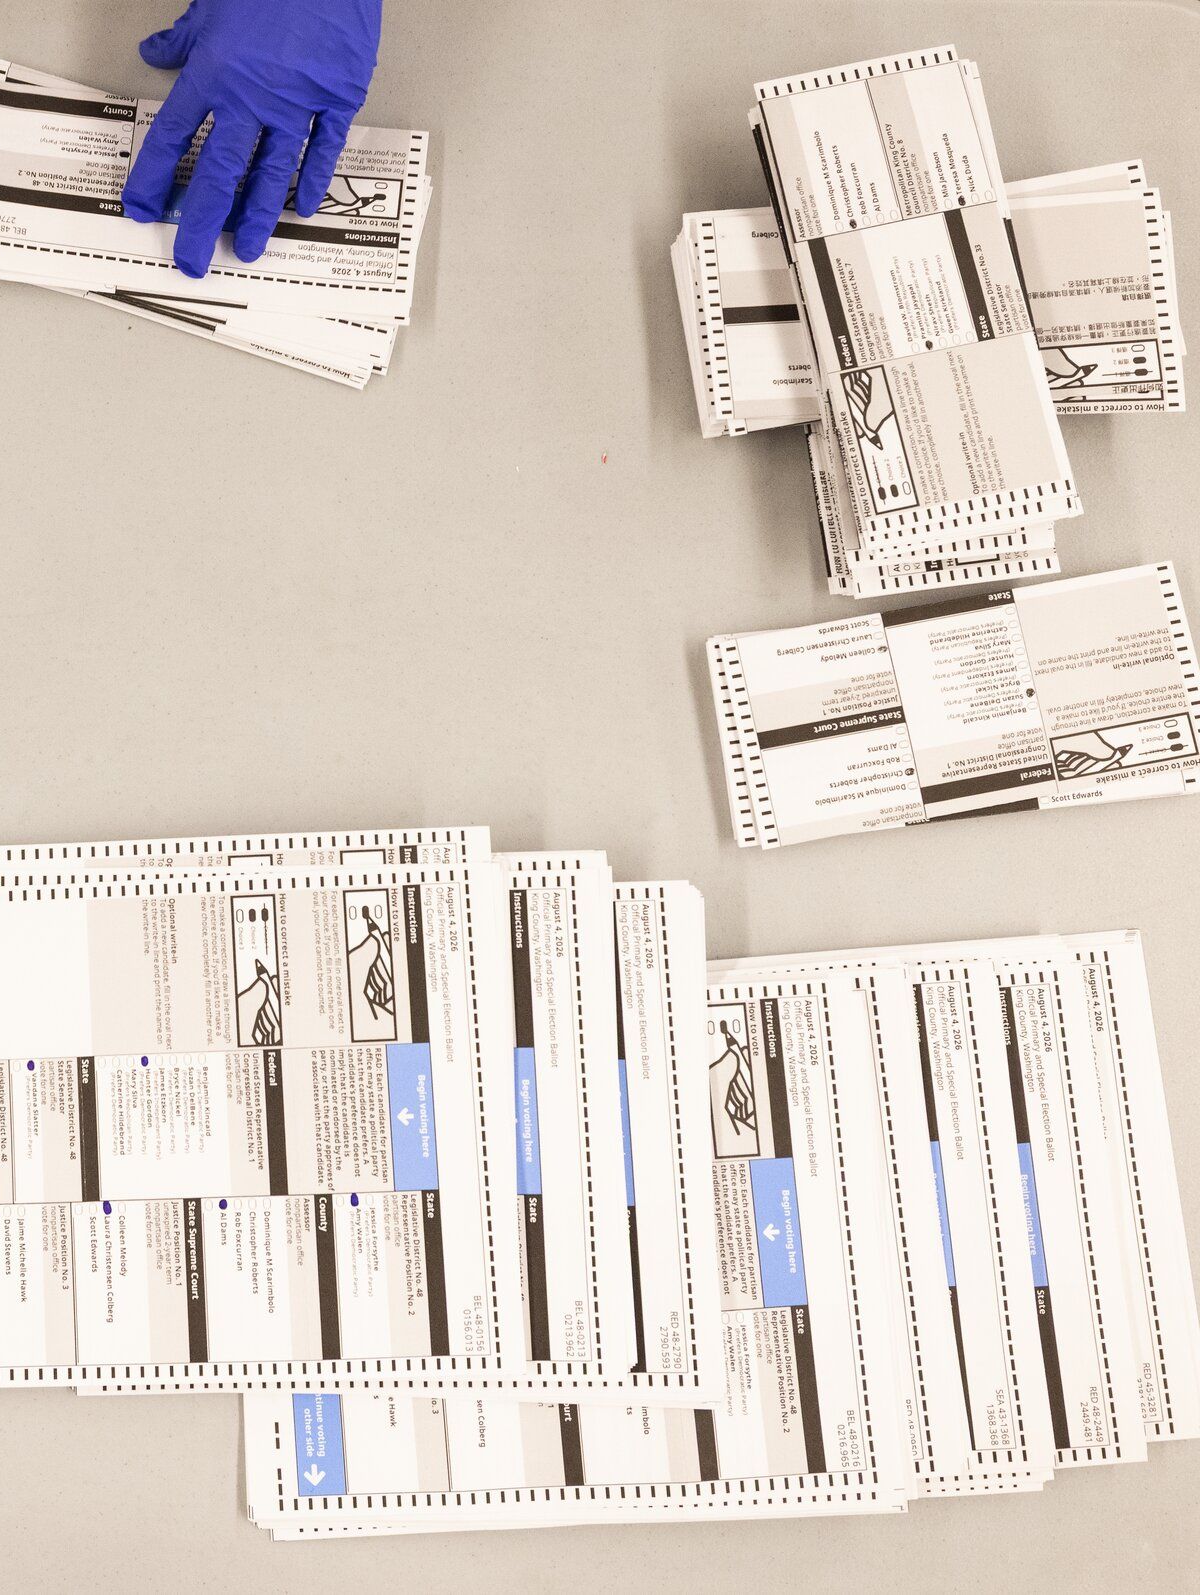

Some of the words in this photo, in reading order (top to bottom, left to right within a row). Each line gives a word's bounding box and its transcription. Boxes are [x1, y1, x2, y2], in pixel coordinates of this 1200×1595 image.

[102, 105, 134, 118] County
[78, 136, 102, 144] Walen
[102, 137, 120, 146] Amy
[884, 123, 896, 150] County
[831, 145, 843, 174] Roberts
[891, 150, 901, 168] King
[942, 132, 956, 170] Mosqueda
[896, 168, 913, 216] Metropolitan
[952, 170, 963, 195] Teresa
[99, 202, 122, 213] State
[839, 175, 854, 218] Christopher
[12, 226, 27, 236] BEL
[751, 231, 779, 239] Colberg
[794, 208, 806, 238] Assessor
[344, 233, 397, 244] Instructions
[331, 267, 352, 276] 2026
[363, 269, 393, 279] August
[978, 315, 991, 339] State
[837, 335, 853, 367] Federal
[772, 377, 813, 386] Scarimbolo
[840, 411, 854, 446] mistake
[850, 454, 864, 486] correct
[862, 499, 872, 518] How
[988, 591, 1011, 601] State
[820, 653, 848, 663] Melody
[848, 647, 876, 657] Colleen
[813, 722, 839, 734] Court
[839, 715, 878, 728] Supreme
[878, 710, 902, 721] State
[1020, 767, 1052, 781] Federal
[1051, 795, 1071, 803] Scott
[1072, 790, 1103, 800] Edwards
[424, 887, 433, 907] King
[445, 886, 455, 918] August
[407, 887, 418, 944] Instructions
[426, 908, 435, 939] County,
[513, 892, 524, 949] Instructions
[449, 930, 459, 952] 2026
[428, 942, 438, 993] Washington
[764, 1001, 777, 1058] Instructions
[268, 1051, 278, 1086] Federal
[416, 1074, 427, 1101] Begin
[419, 1103, 429, 1135] voting
[422, 1135, 430, 1158] here
[187, 1201, 196, 1227] State
[318, 1197, 328, 1232] County
[354, 1207, 362, 1227] Amy
[426, 1192, 435, 1219] State
[529, 1197, 538, 1223] State
[220, 1222, 228, 1246] Dams
[263, 1210, 272, 1257] Dominique
[187, 1228, 198, 1271] Supreme
[105, 1240, 113, 1290] Christensen
[190, 1272, 199, 1300] Court
[266, 1267, 275, 1314] Scarimbolo
[105, 1291, 115, 1323] Colberg
[473, 1295, 482, 1312] BEL
[574, 1300, 584, 1317] BEL
[1036, 1289, 1046, 1315] State
[462, 1309, 474, 1352] 0156.013
[474, 1313, 485, 1352] 48-0156
[670, 1311, 679, 1329] RED
[795, 1308, 805, 1334] State
[564, 1314, 575, 1357] 0213.962
[576, 1319, 586, 1357] 48-0213
[659, 1326, 671, 1369] 2790.593
[770, 1310, 784, 1374] Representative
[671, 1330, 682, 1369] 48-2790
[1143, 1362, 1152, 1380] RED
[777, 1375, 787, 1410] Position
[995, 1389, 1005, 1406] SEA
[1089, 1386, 1099, 1404] RED
[1145, 1381, 1157, 1417] 45-3281
[781, 1411, 789, 1426] No.
[846, 1409, 856, 1427] BEL
[986, 1404, 999, 1446] 1368.368
[998, 1407, 1010, 1445] 43-1368
[1080, 1402, 1093, 1442] 2449.481
[1092, 1405, 1104, 1443] 48-2449
[837, 1424, 850, 1468] 0216.965
[849, 1428, 861, 1467] 48-0216
